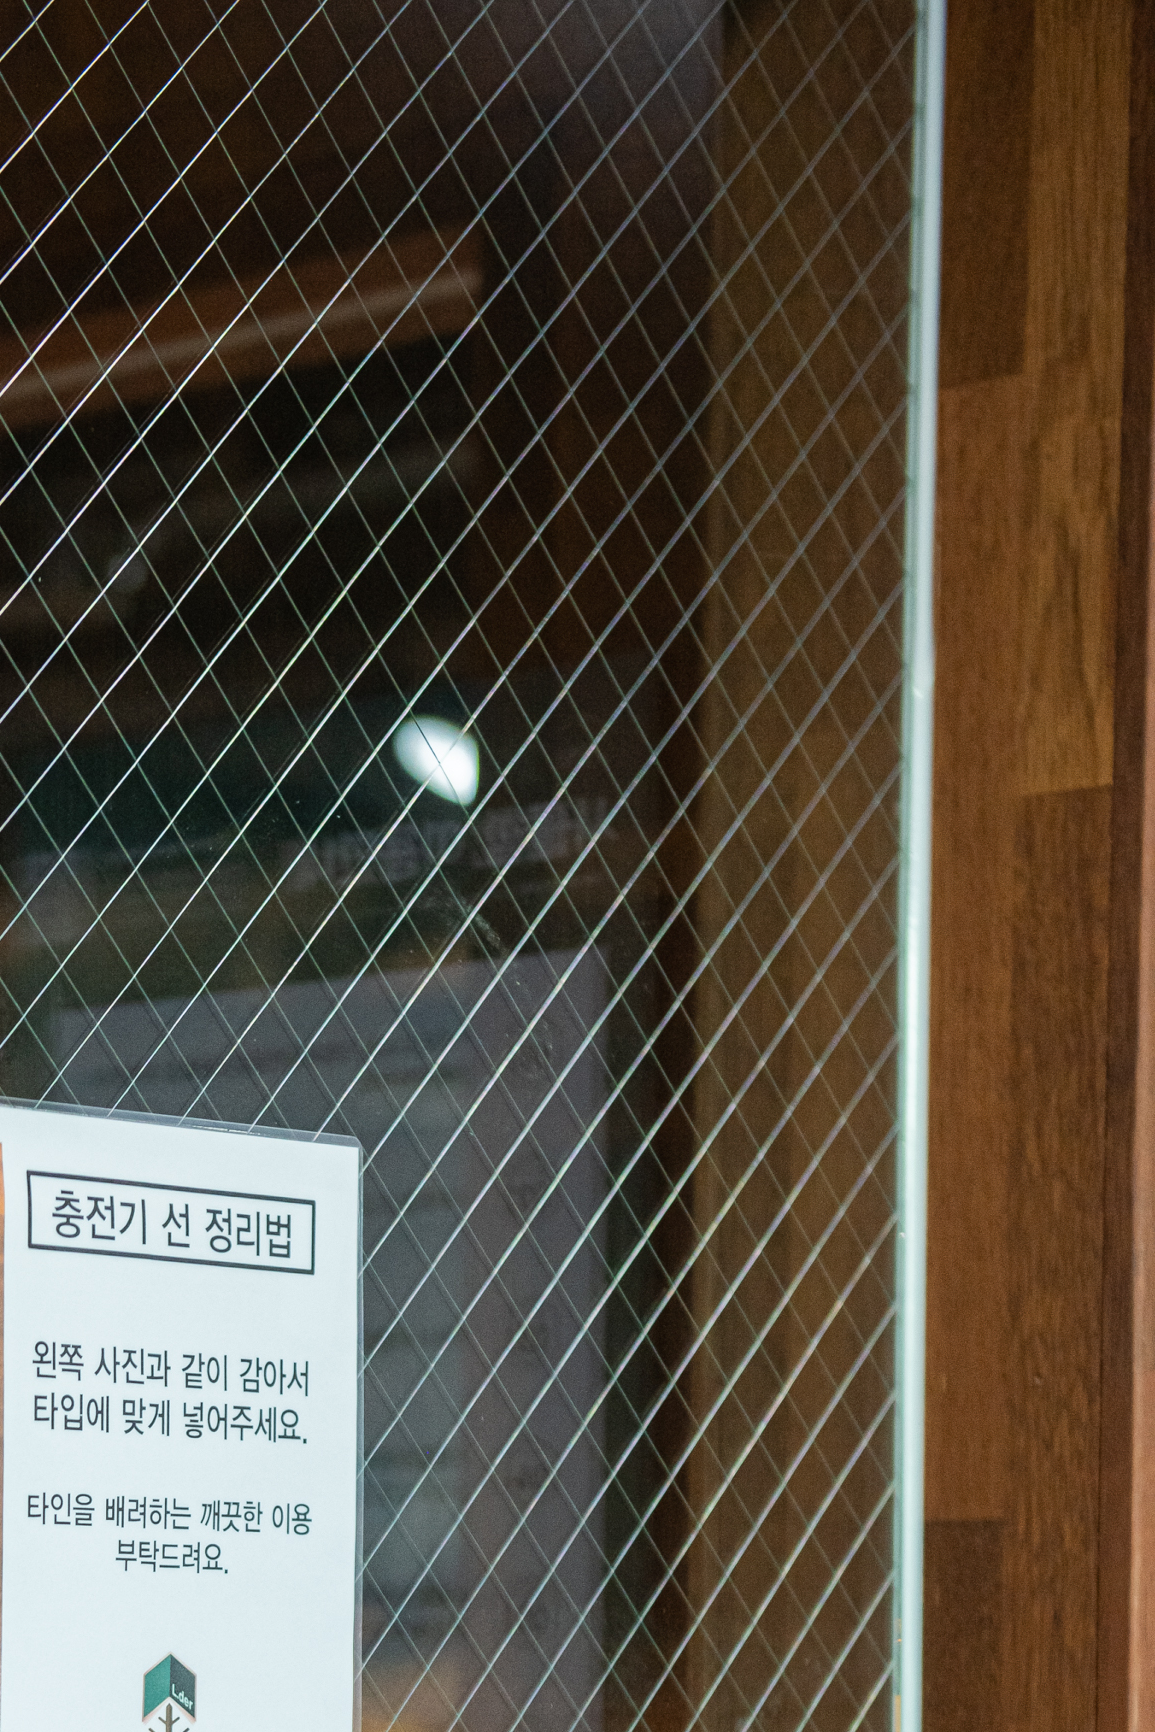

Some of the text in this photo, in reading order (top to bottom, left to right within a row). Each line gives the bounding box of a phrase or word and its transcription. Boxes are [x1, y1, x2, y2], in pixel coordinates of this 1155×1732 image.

[51, 1189, 293, 1259] 충전기 선 정리법
[32, 1340, 310, 1397] 왼쪽 사진과 같이 감아서
[33, 1392, 308, 1444] 타입에 맞게 넣어주세요.
[27, 1492, 313, 1536] 타인을 배려하는 깨끗한 이용
[115, 1538, 229, 1575] 부탁드려요.
